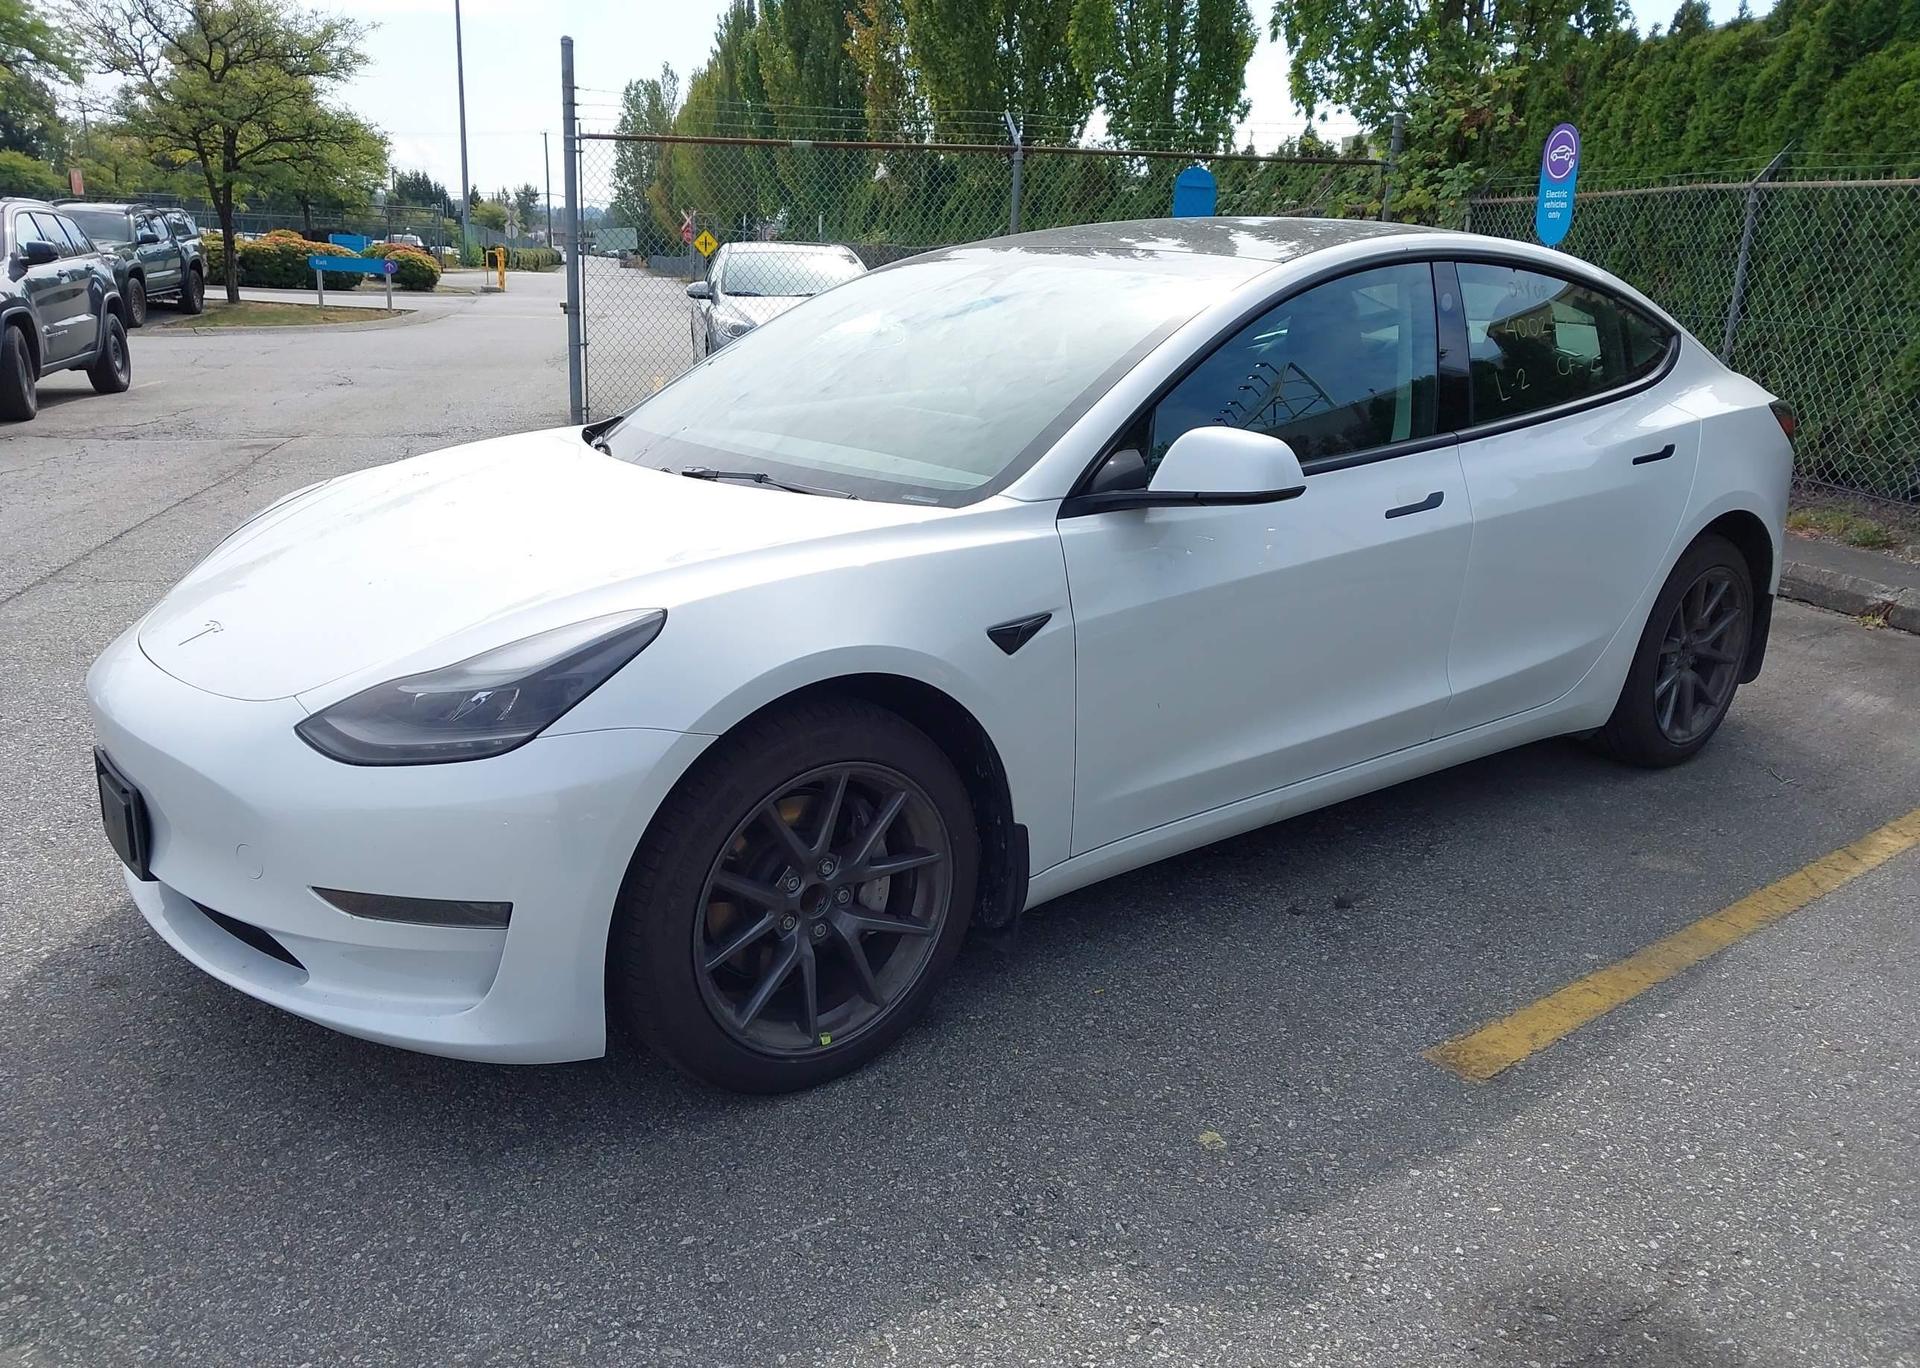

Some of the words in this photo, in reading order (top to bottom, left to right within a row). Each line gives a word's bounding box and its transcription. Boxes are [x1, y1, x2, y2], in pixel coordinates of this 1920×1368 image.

[1545, 189, 1568, 198] Electric
[1543, 200, 1567, 209] vehicles
[1547, 211, 1561, 220] only
